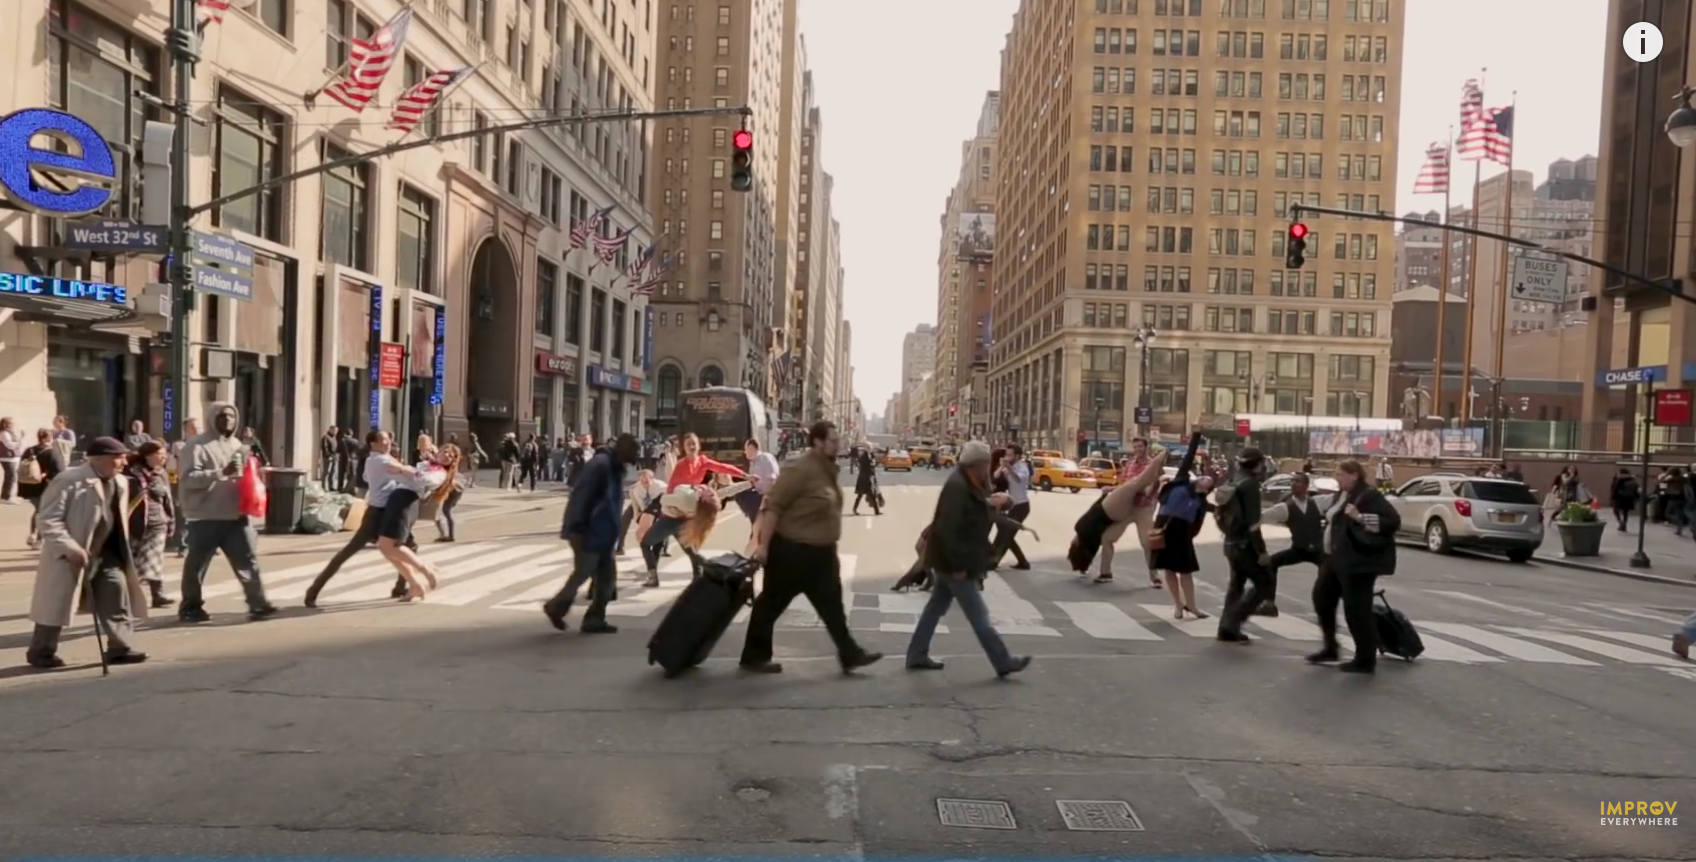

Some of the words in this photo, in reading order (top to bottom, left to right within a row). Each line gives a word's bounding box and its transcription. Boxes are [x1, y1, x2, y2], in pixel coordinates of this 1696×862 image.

[0, 108, 116, 214] e
[73, 228, 110, 243] West
[112, 230, 140, 245] 32nd
[143, 231, 158, 246] St
[198, 239, 235, 261] Seventh
[235, 250, 252, 267] Ave
[1525, 260, 1558, 273] BUSES
[198, 271, 232, 292] Fashion
[232, 280, 249, 296] Ave
[1526, 275, 1553, 286] ONLY
[1605, 371, 1642, 383] CHASE
